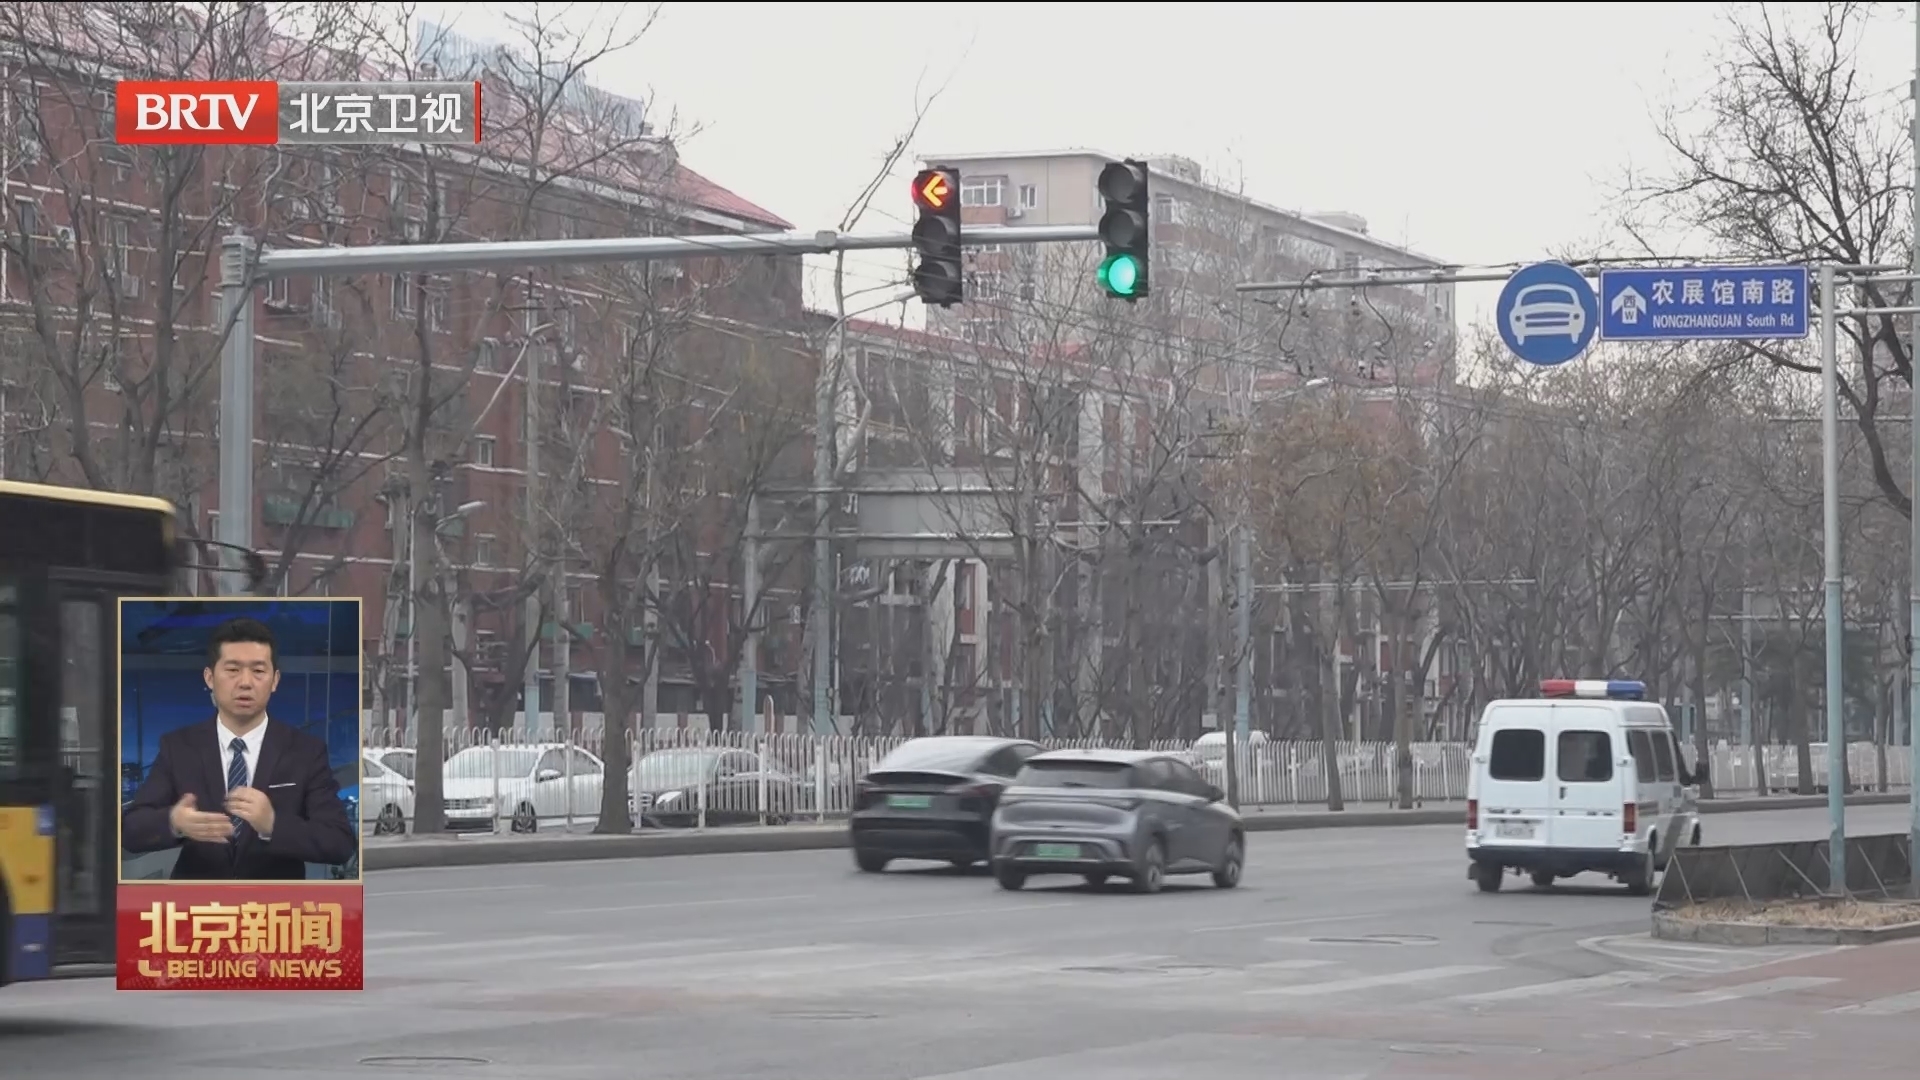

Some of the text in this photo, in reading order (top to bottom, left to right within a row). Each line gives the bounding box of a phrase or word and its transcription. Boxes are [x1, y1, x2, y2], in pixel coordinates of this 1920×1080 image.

[1651, 278, 1796, 306] 农展馆南路
[1623, 294, 1636, 309] 西
[1624, 310, 1635, 321] W
[1652, 314, 1794, 329] NONGZHANGUAN South Rd
